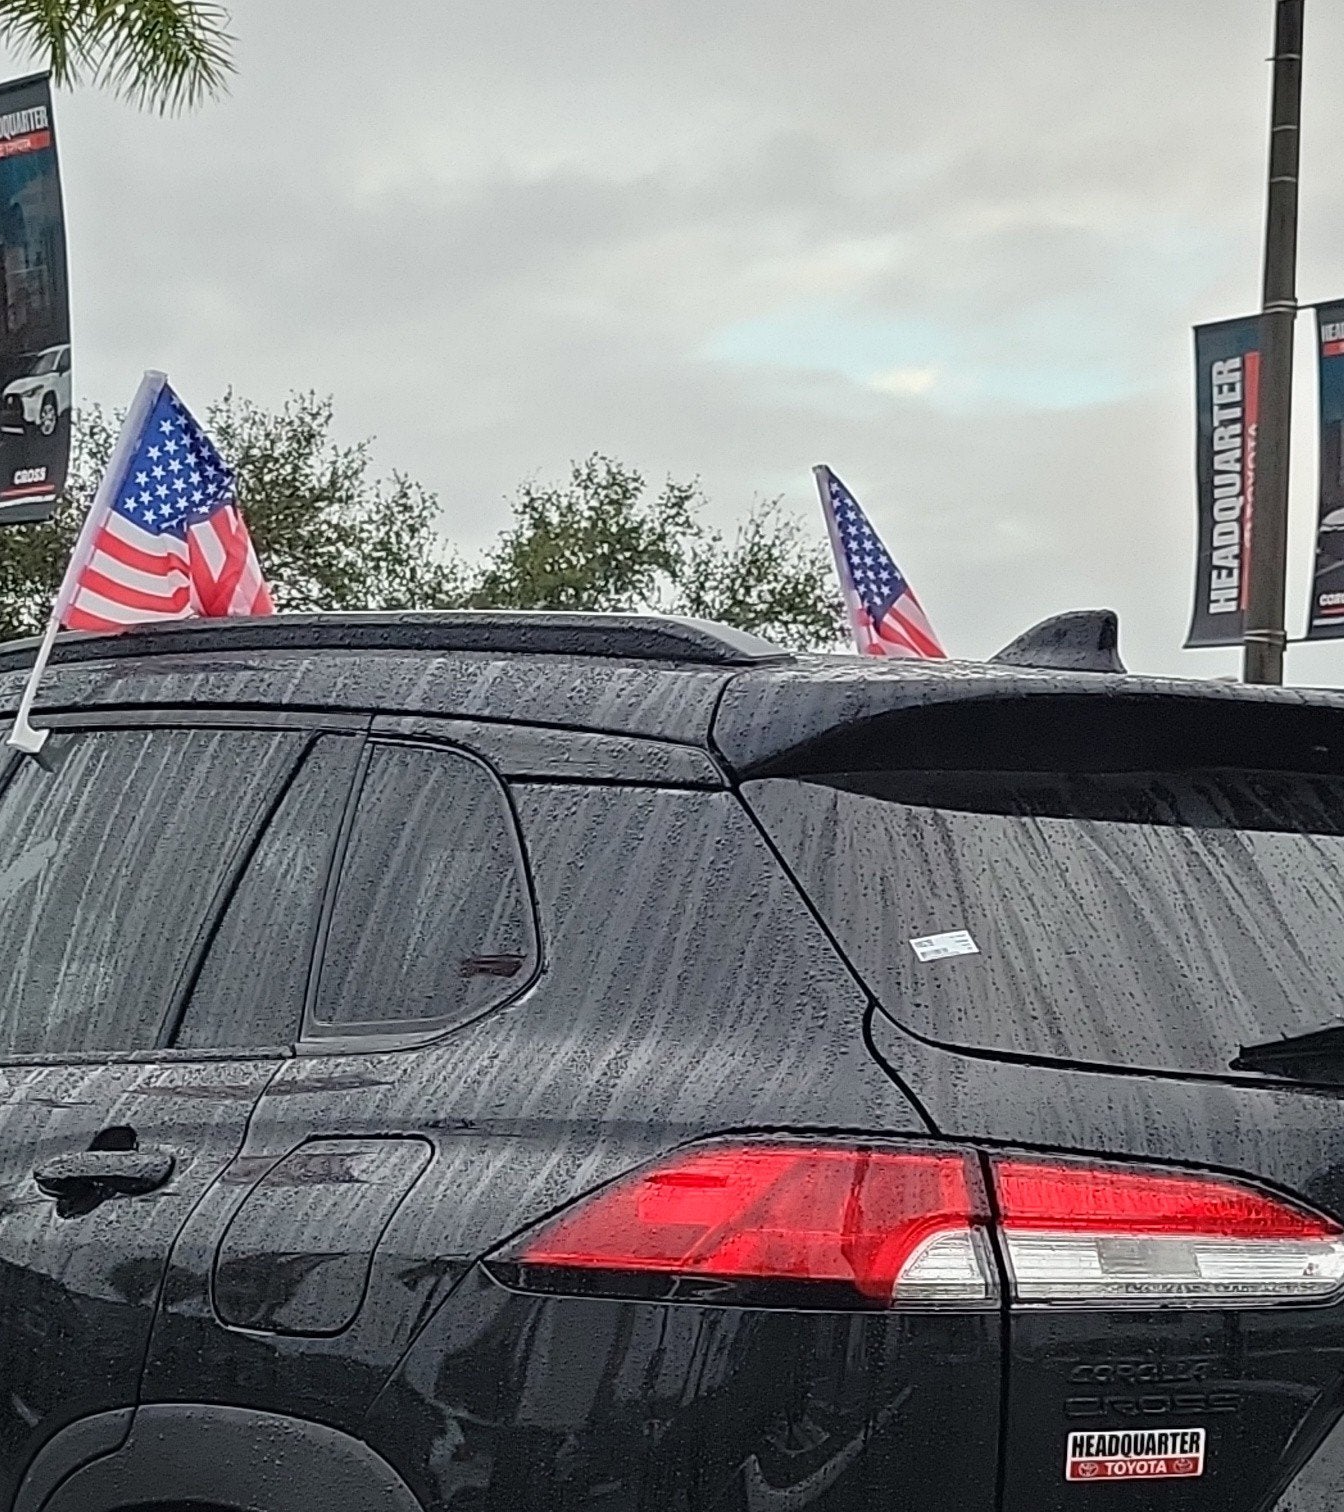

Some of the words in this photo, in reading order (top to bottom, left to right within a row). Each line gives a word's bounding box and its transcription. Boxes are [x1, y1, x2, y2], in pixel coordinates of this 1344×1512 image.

[13, 466, 47, 485] CROSS
[1208, 356, 1244, 614] HEADQUARTER
[1064, 1393, 1240, 1417] CROSS
[1070, 1431, 1202, 1458] HEADQUARTER
[1105, 1460, 1167, 1476] TOYOTA
